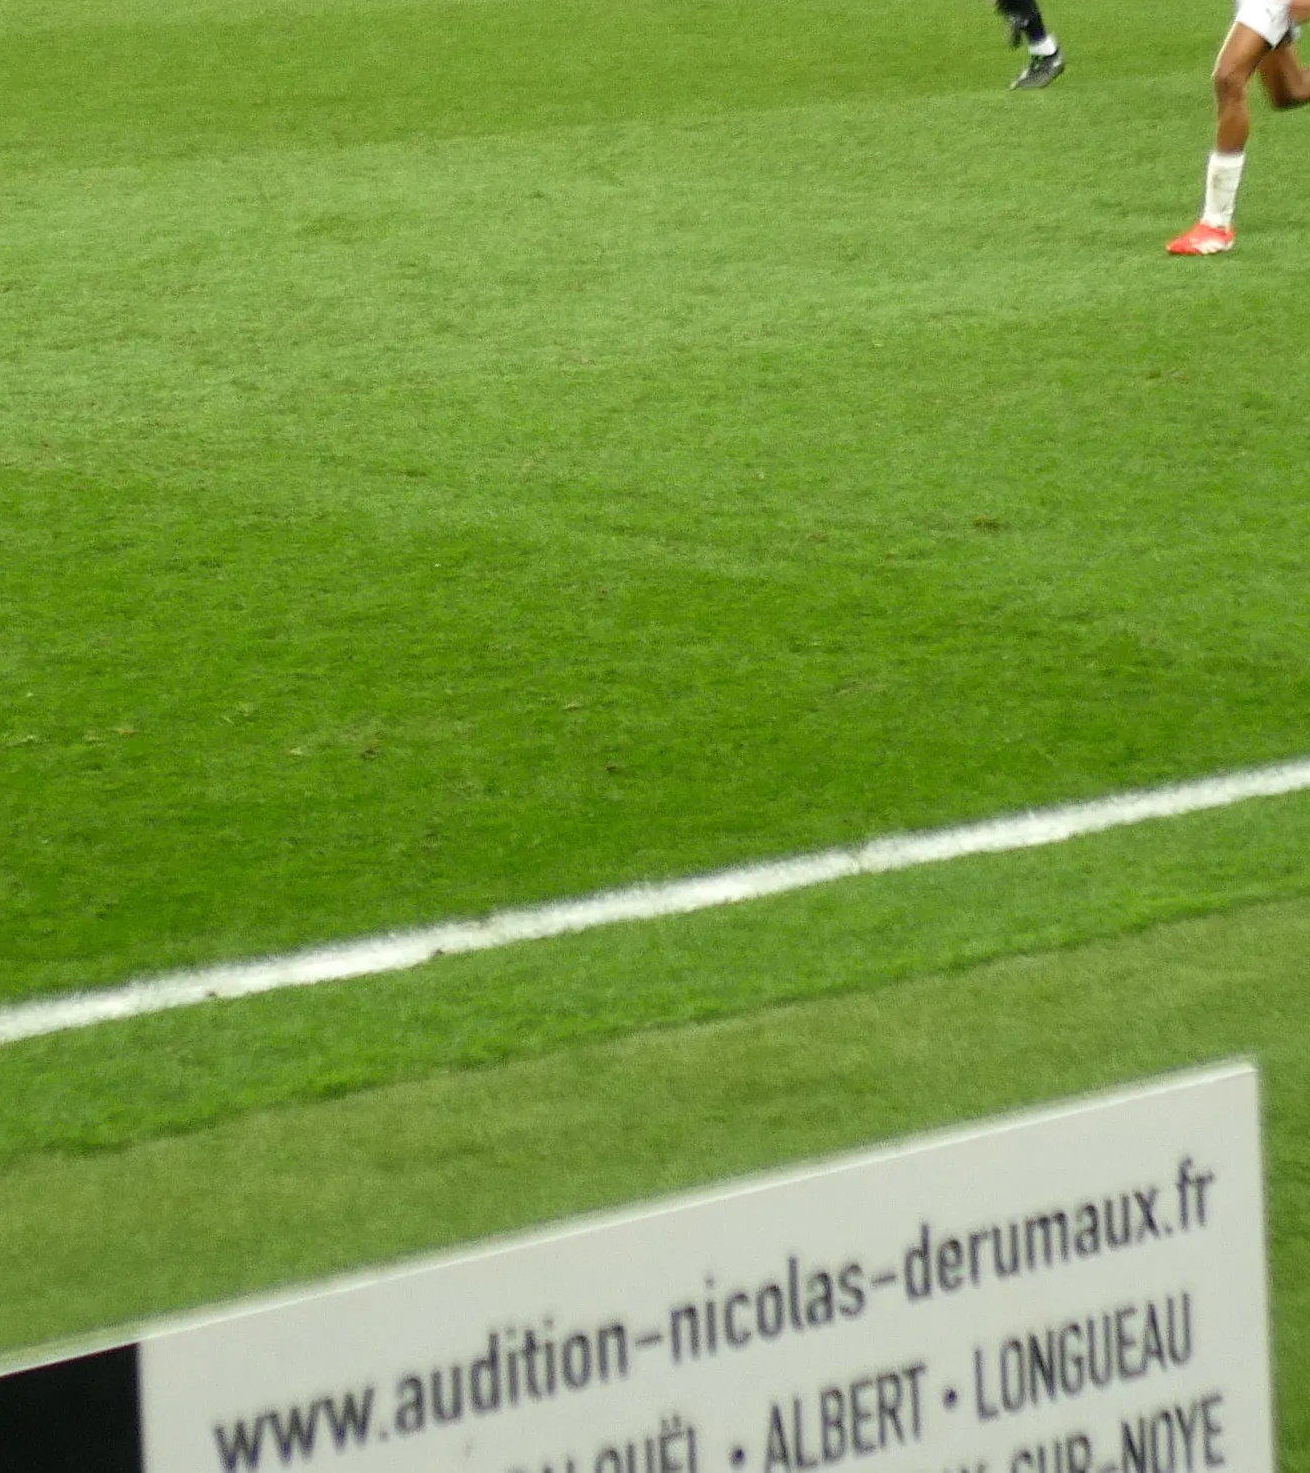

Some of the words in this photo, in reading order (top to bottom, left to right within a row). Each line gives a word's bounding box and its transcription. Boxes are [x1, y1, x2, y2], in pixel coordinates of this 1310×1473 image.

[211, 1153, 1216, 1472] www.audition-nicolas-derumaux.fr
[762, 1361, 927, 1473] ALBERT
[973, 1292, 1194, 1423] LONGUEAU
